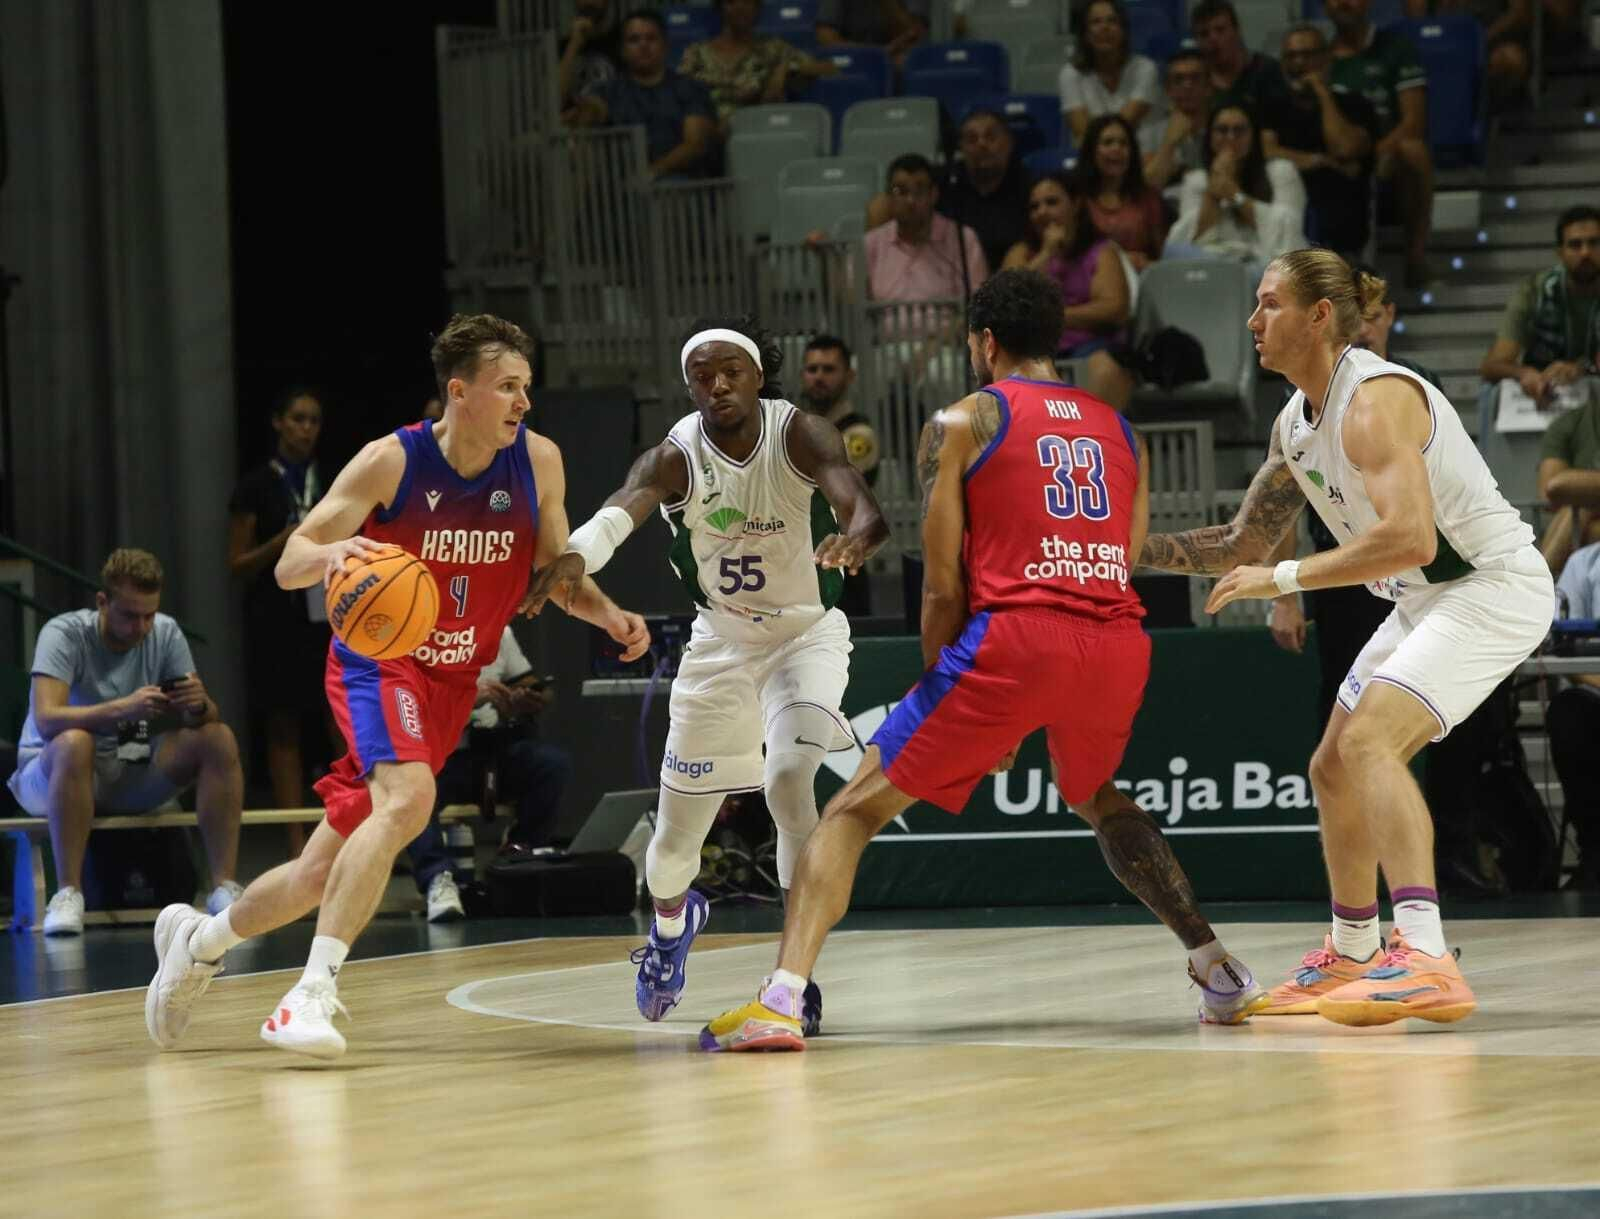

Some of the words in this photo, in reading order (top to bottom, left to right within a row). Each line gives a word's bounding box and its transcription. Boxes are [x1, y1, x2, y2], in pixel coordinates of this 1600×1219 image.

[1036, 434, 1111, 521] 33
[420, 529, 515, 565] HEROES
[1040, 534, 1083, 560] the
[1087, 543, 1126, 567] rent
[718, 555, 766, 596] 55
[1023, 559, 1128, 593] company
[449, 575, 470, 618] 4
[1232, 761, 1319, 811] Ba
